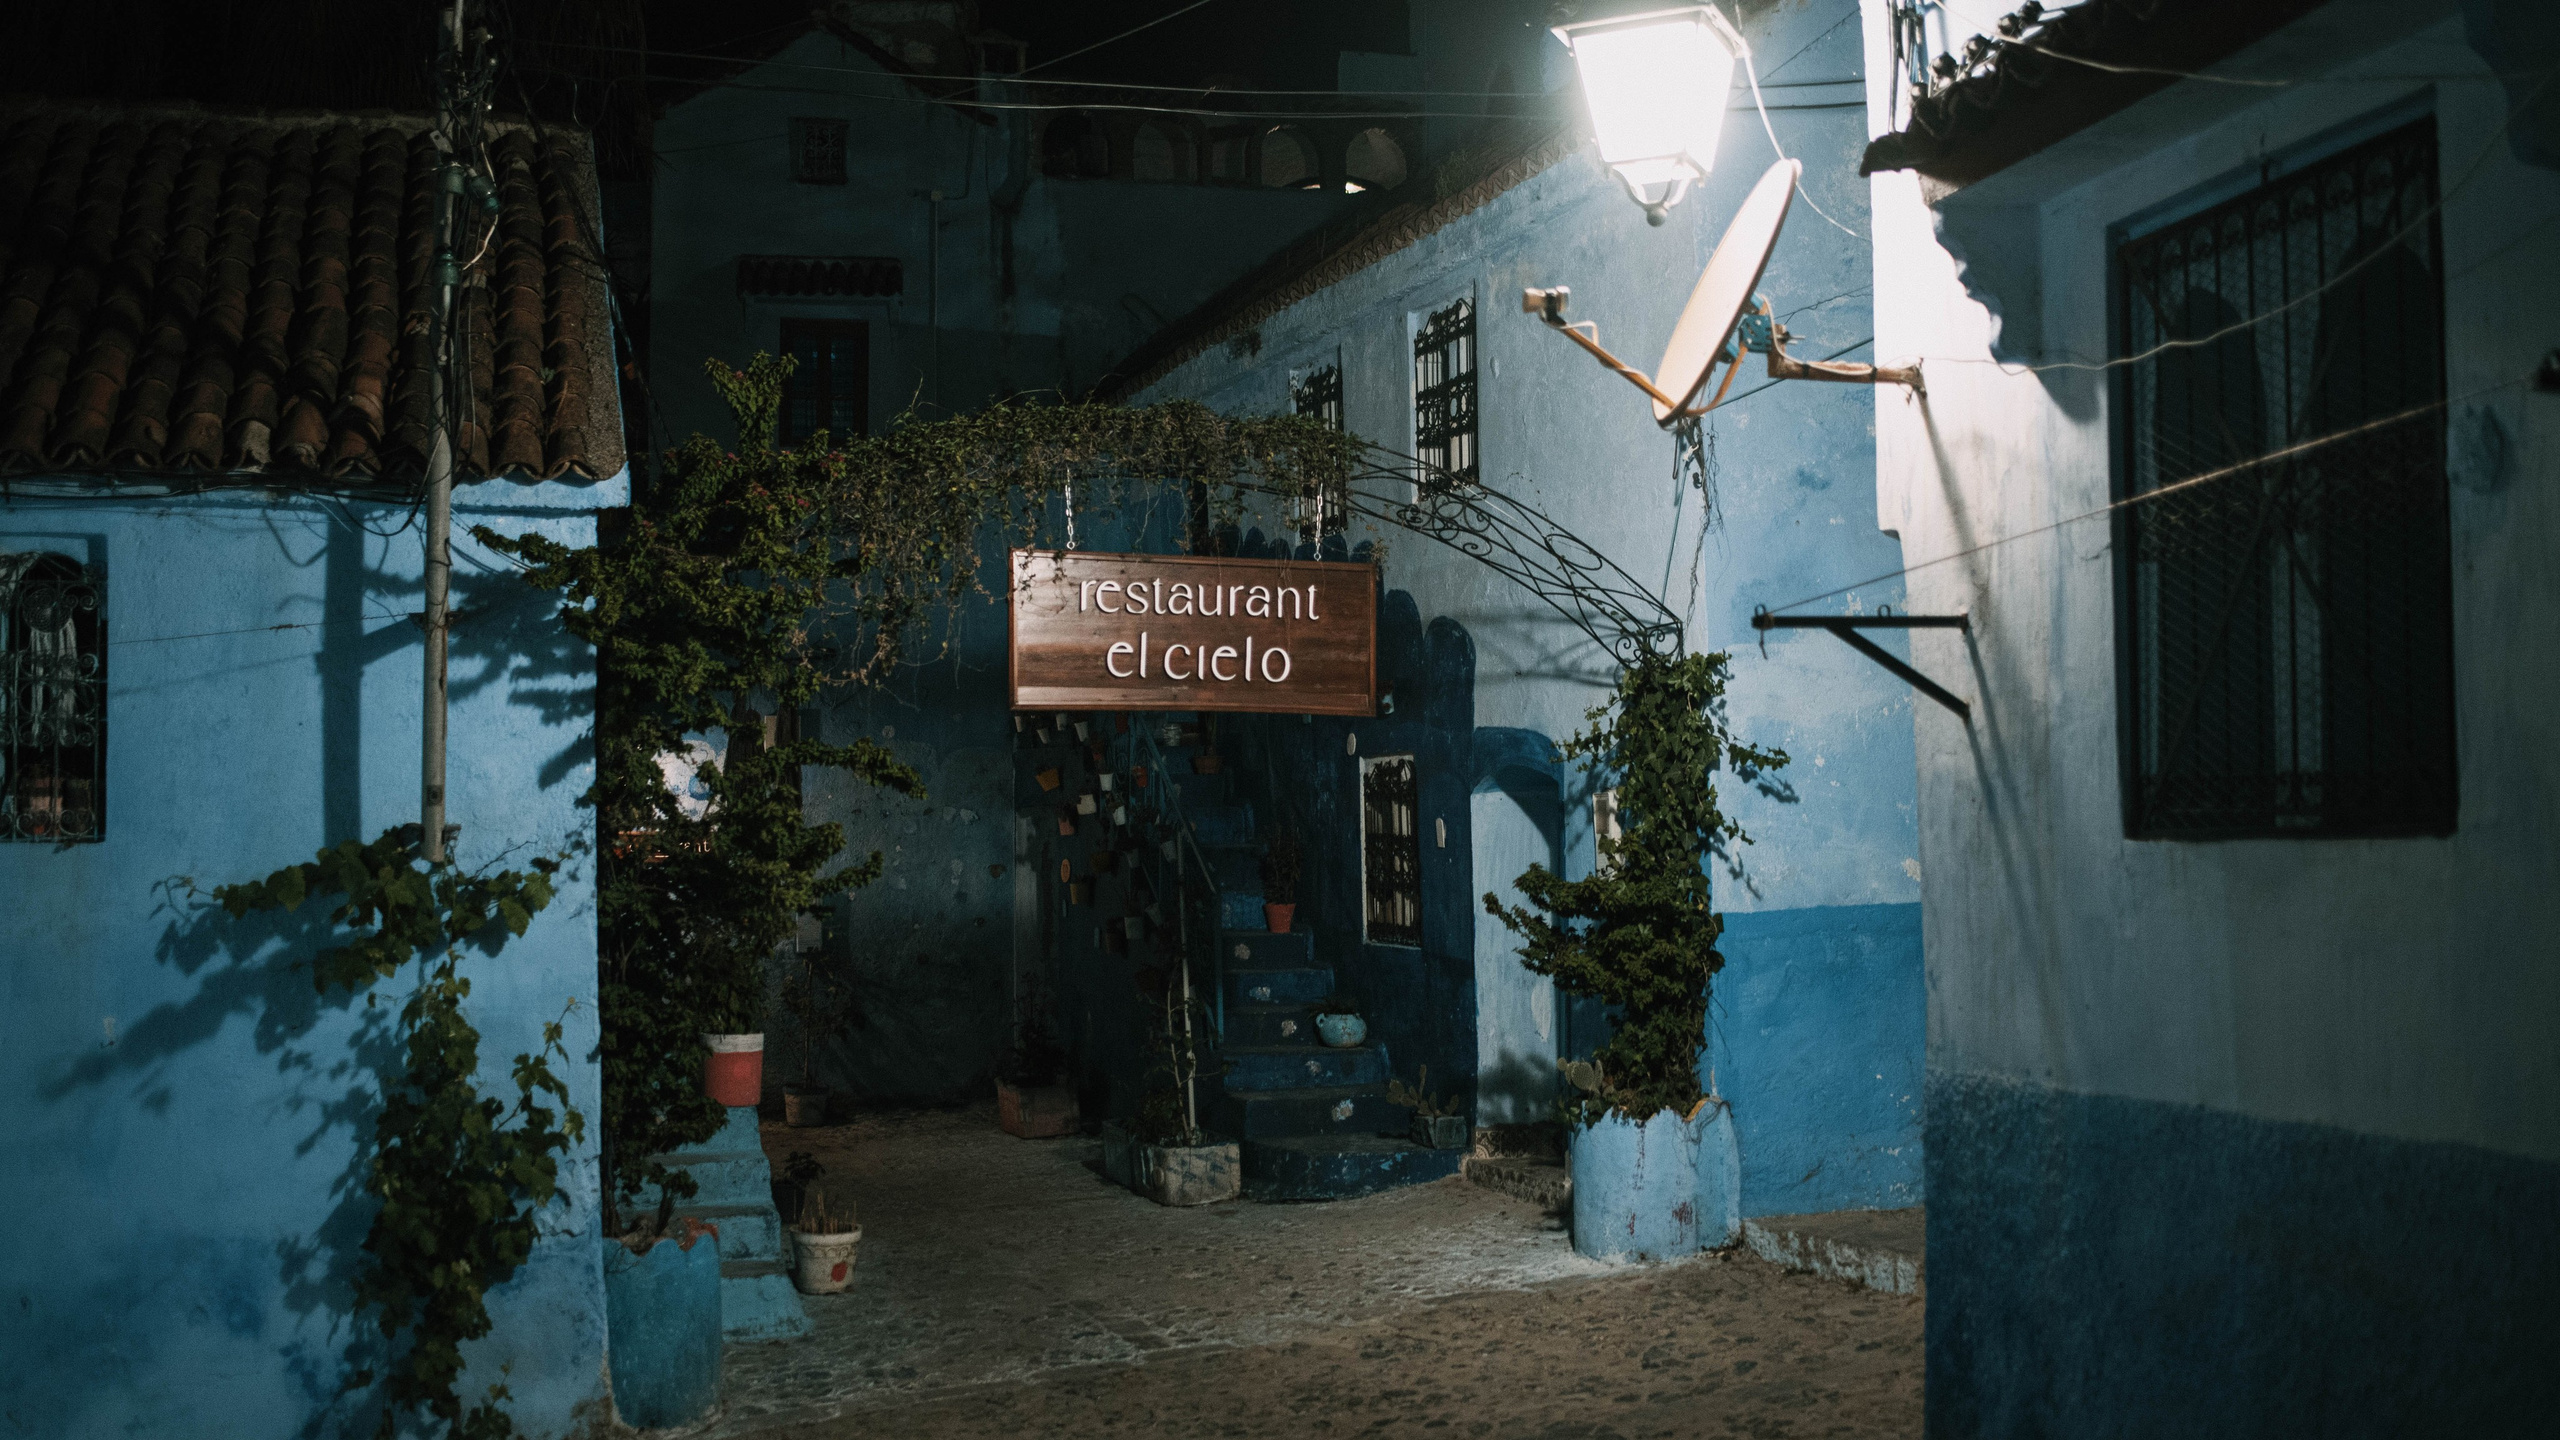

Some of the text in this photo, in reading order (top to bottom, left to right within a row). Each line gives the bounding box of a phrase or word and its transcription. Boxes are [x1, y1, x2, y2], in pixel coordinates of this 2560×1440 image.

[1079, 577, 1320, 621] restaurant
[1106, 631, 1292, 683] el cielo
